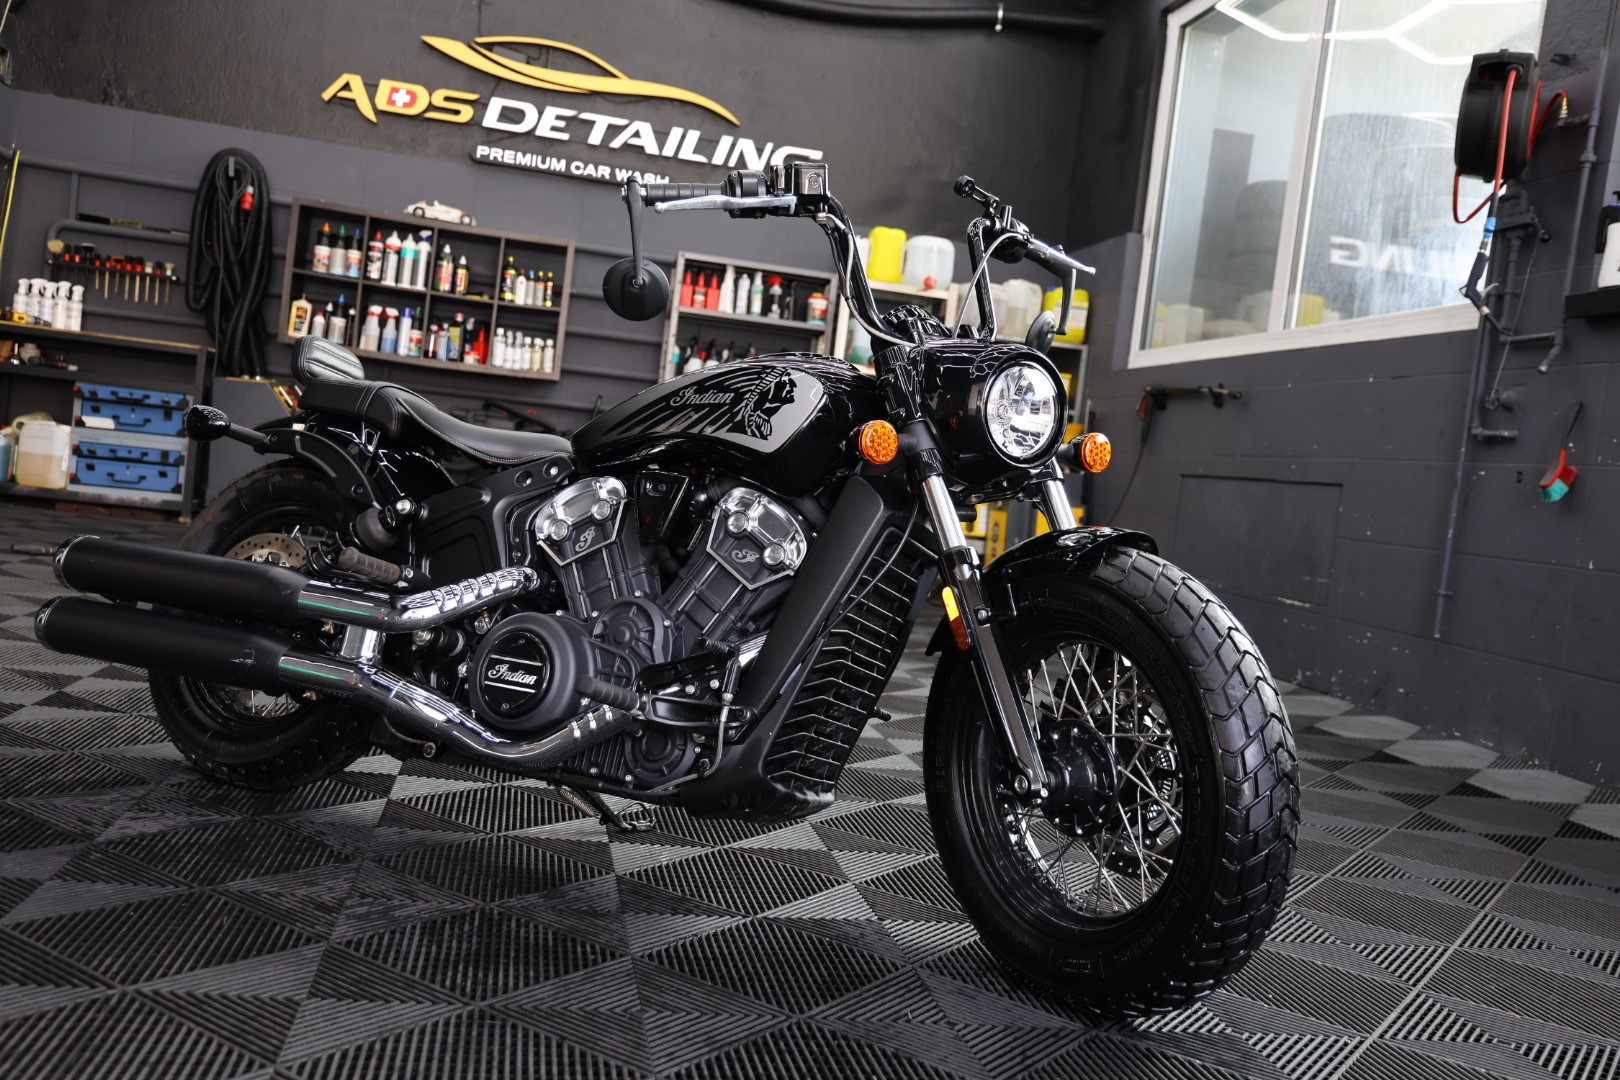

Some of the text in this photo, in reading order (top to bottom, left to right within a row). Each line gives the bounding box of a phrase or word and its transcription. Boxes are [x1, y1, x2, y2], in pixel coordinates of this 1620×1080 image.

[320, 72, 480, 124] ADS
[476, 145, 670, 185] PREMIUM CAR WASH
[670, 385, 735, 407] Indian
[487, 663, 538, 685] Indian
